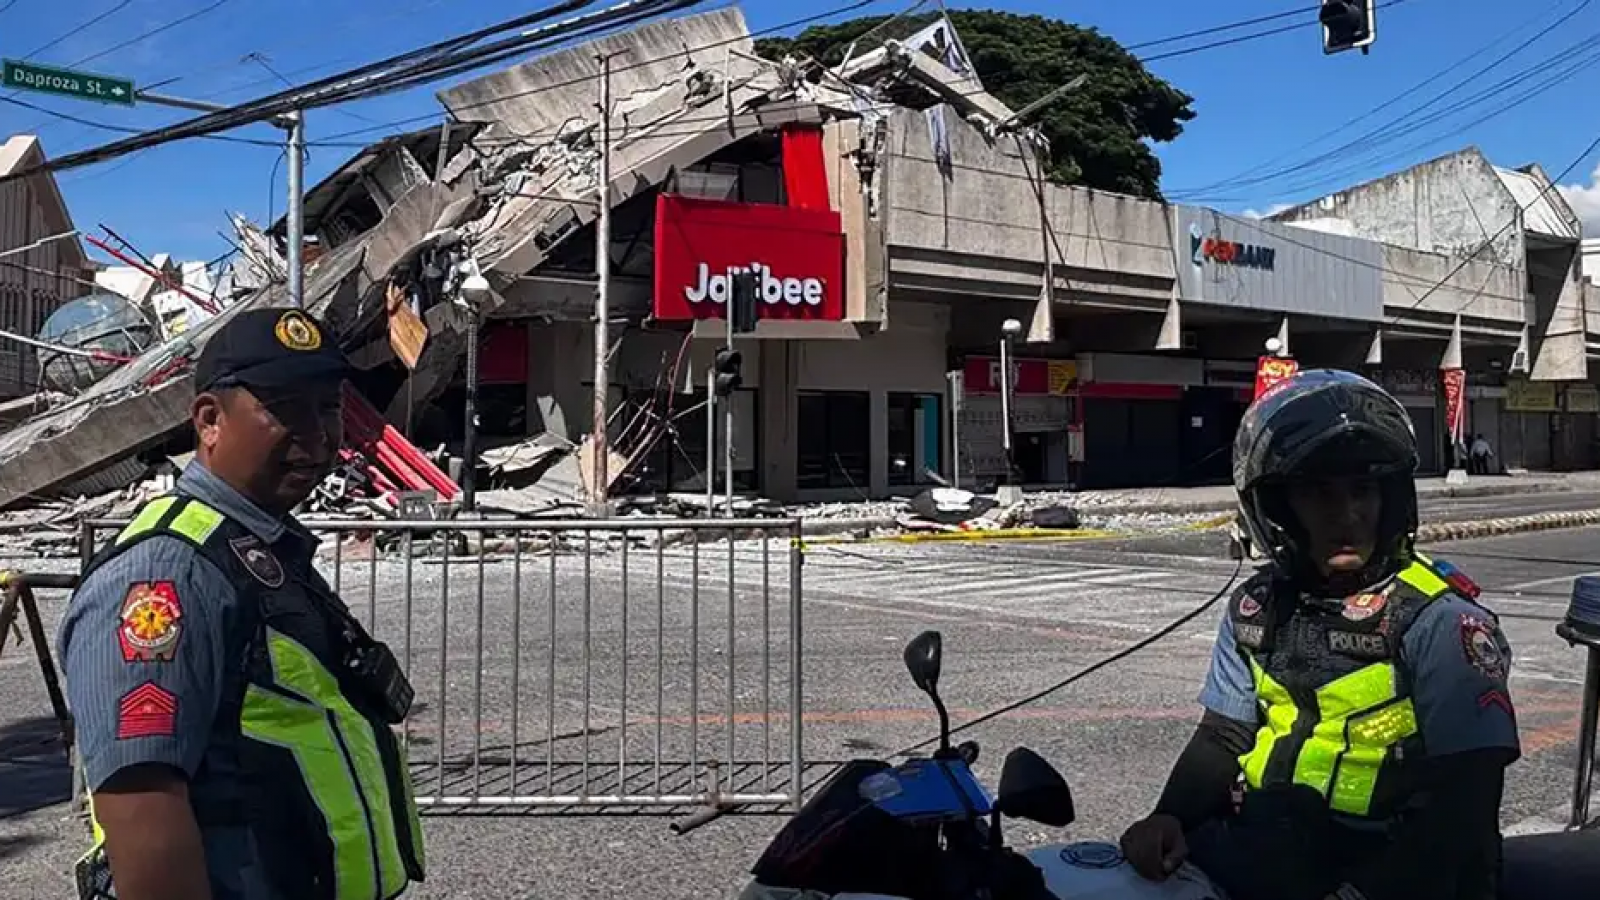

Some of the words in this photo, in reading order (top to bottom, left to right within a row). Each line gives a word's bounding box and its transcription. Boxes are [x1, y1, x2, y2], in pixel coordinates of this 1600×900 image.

[14, 68, 79, 91] Daproza
[86, 80, 106, 95] St.
[685, 262, 823, 305] Joibee
[1329, 631, 1384, 651] POLICE
